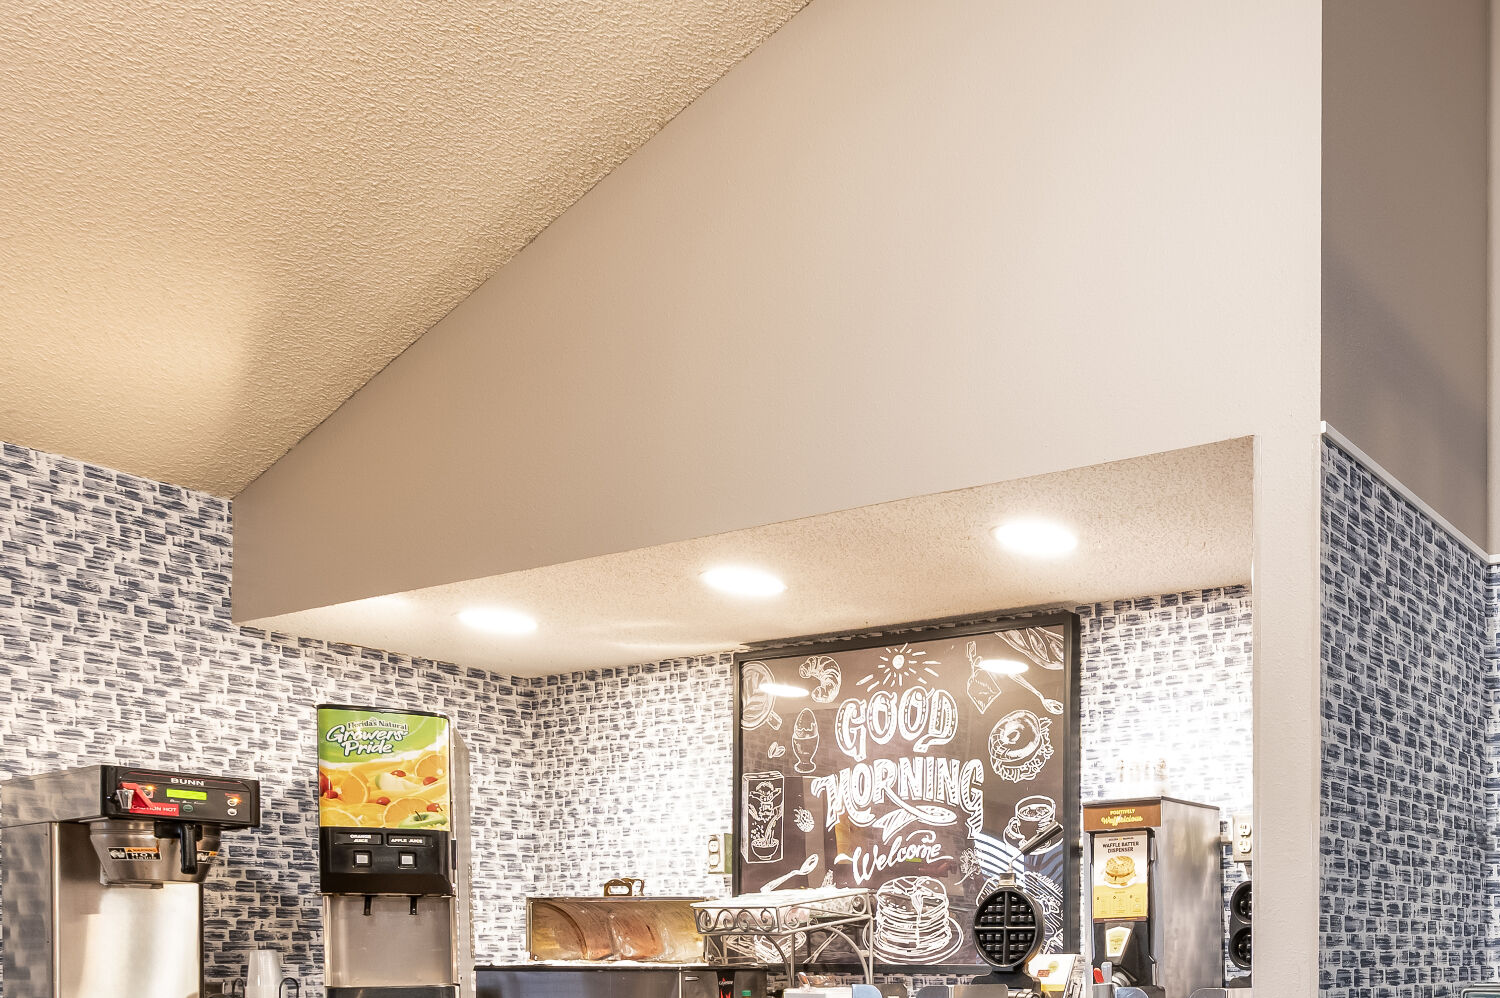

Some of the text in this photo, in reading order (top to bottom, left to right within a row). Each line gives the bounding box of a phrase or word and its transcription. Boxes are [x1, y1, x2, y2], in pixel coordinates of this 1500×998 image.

[378, 720, 407, 730] Natural
[835, 686, 958, 761] GOOD
[341, 739, 394, 757] Pride
[170, 777, 205, 786] BUNN
[811, 756, 985, 839] MORNING
[834, 829, 953, 885] Welcome
